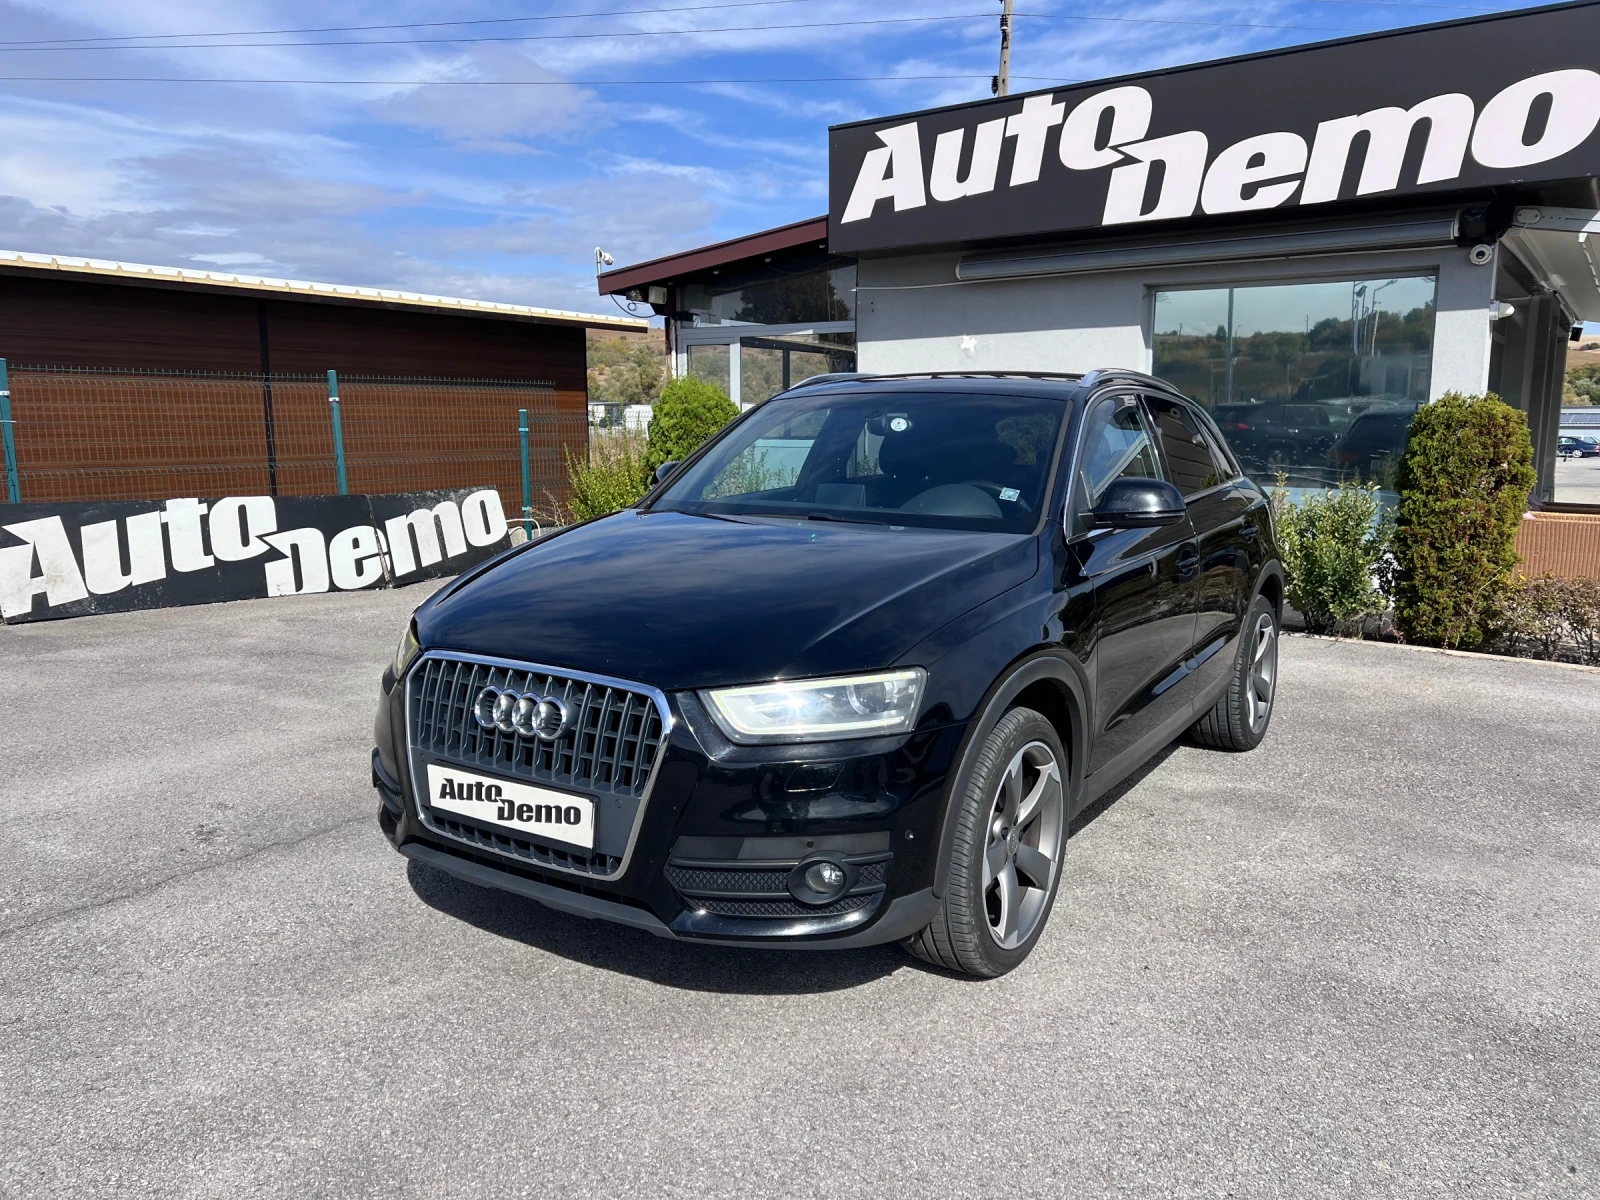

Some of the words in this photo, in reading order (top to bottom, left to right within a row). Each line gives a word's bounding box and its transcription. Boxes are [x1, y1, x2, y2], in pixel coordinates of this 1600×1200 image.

[841, 86, 1153, 224] Auto
[1102, 69, 1600, 225] Demo
[0, 496, 277, 618] Auto
[264, 489, 507, 597] Demo
[439, 777, 502, 803] Auto
[497, 799, 581, 826] Demo
